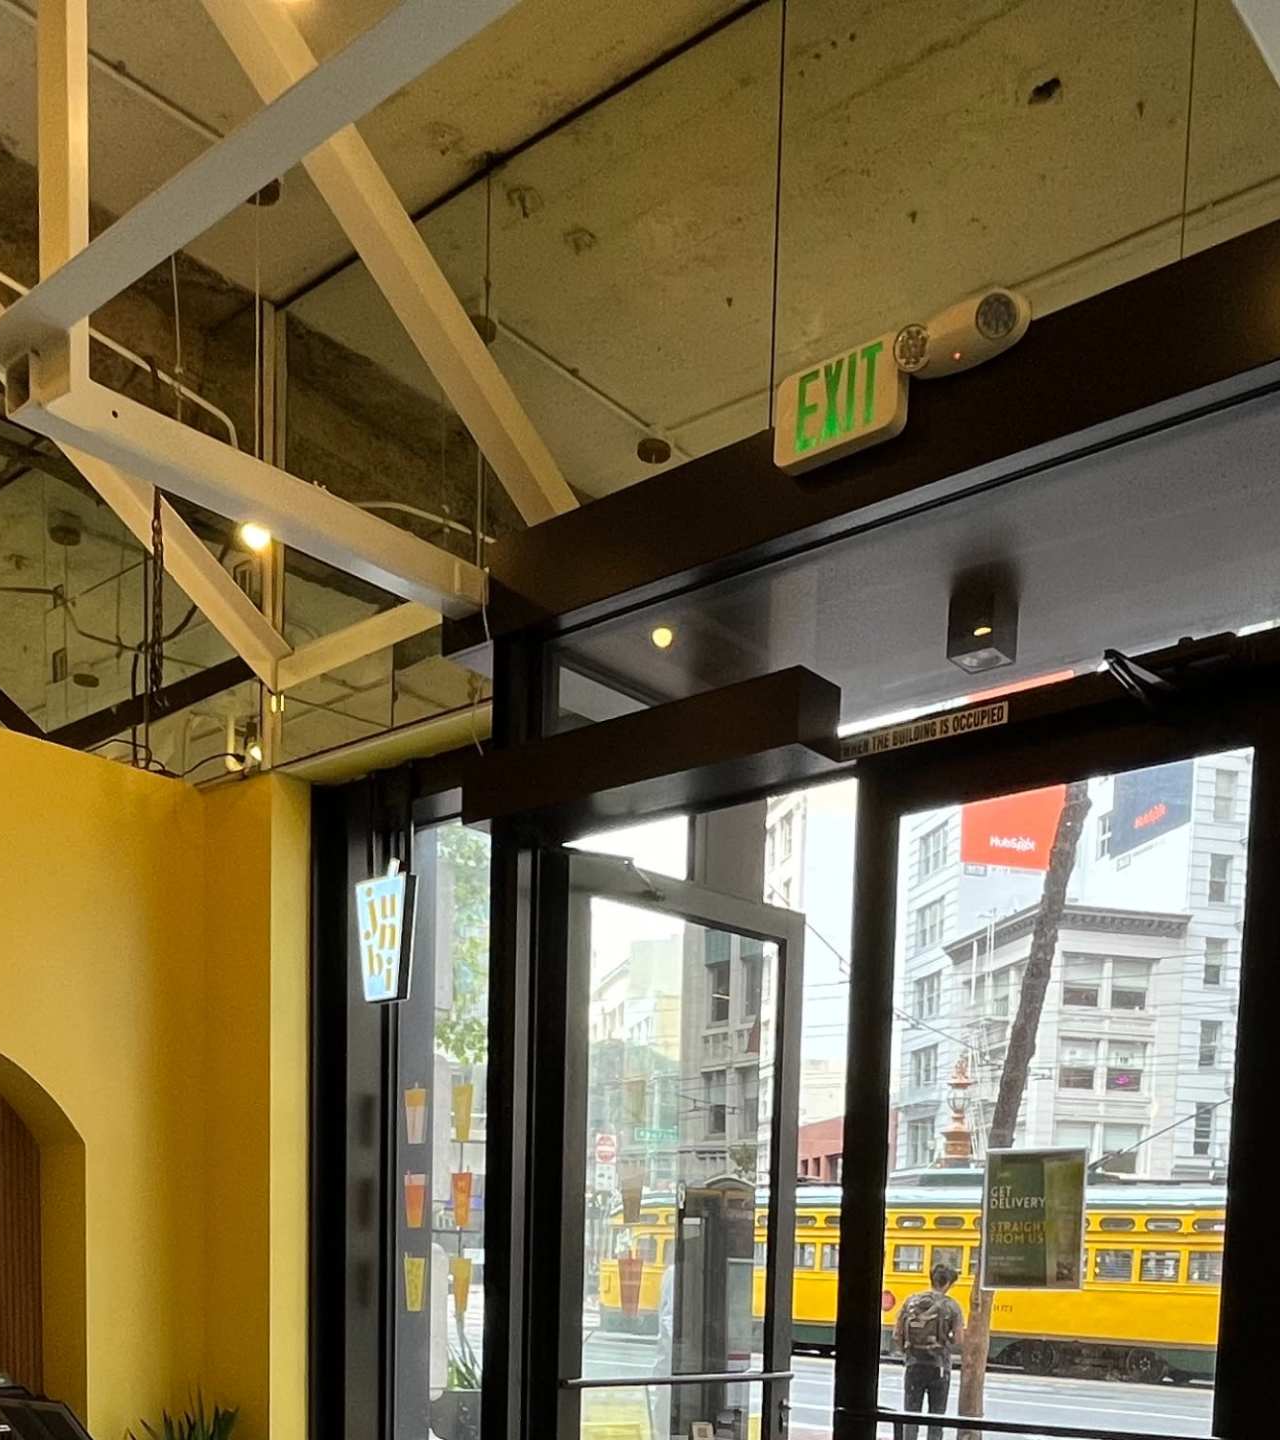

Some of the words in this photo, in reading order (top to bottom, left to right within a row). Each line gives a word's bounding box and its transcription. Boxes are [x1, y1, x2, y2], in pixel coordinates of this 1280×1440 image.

[794, 341, 884, 455] EXIT
[871, 733, 889, 749] THE
[892, 722, 937, 747] BUILDING
[939, 718, 949, 735] IS
[952, 706, 1004, 732] OCCUPIED
[990, 1186, 1012, 1198] GET
[990, 1197, 1046, 1209] DELIVERY
[991, 1233, 1024, 1245] FROM
[1028, 1234, 1045, 1244] US
